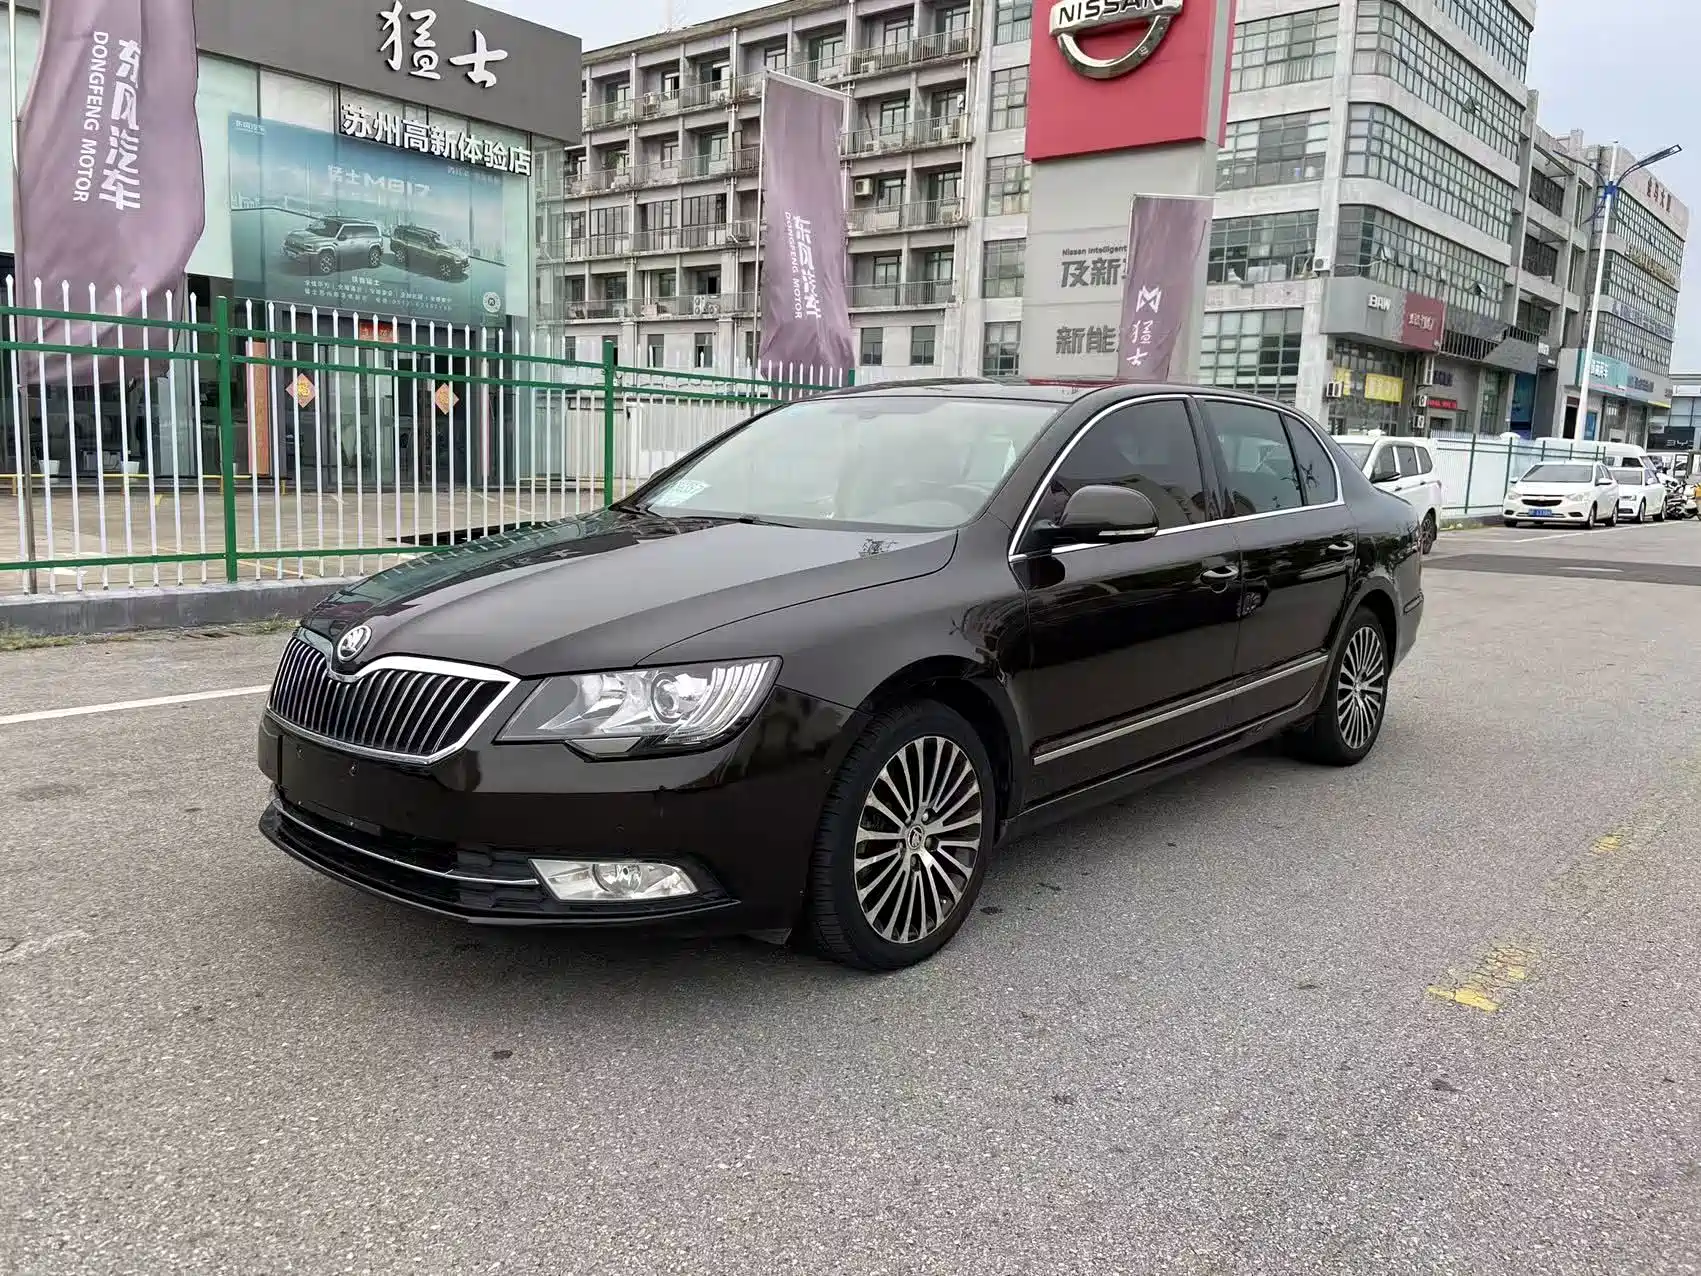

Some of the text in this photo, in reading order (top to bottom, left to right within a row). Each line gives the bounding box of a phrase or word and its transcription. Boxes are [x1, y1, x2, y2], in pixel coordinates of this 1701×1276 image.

[380, 0, 509, 89] 猛士
[73, 31, 109, 202] DONGFENG MOTOR
[340, 104, 533, 176] 苏州高新体验店
[785, 211, 803, 319] DONGFENG MOTOR
[1061, 257, 1127, 288] 及新
[1062, 247, 1087, 256] Nissan
[1055, 324, 1120, 354] 新能
